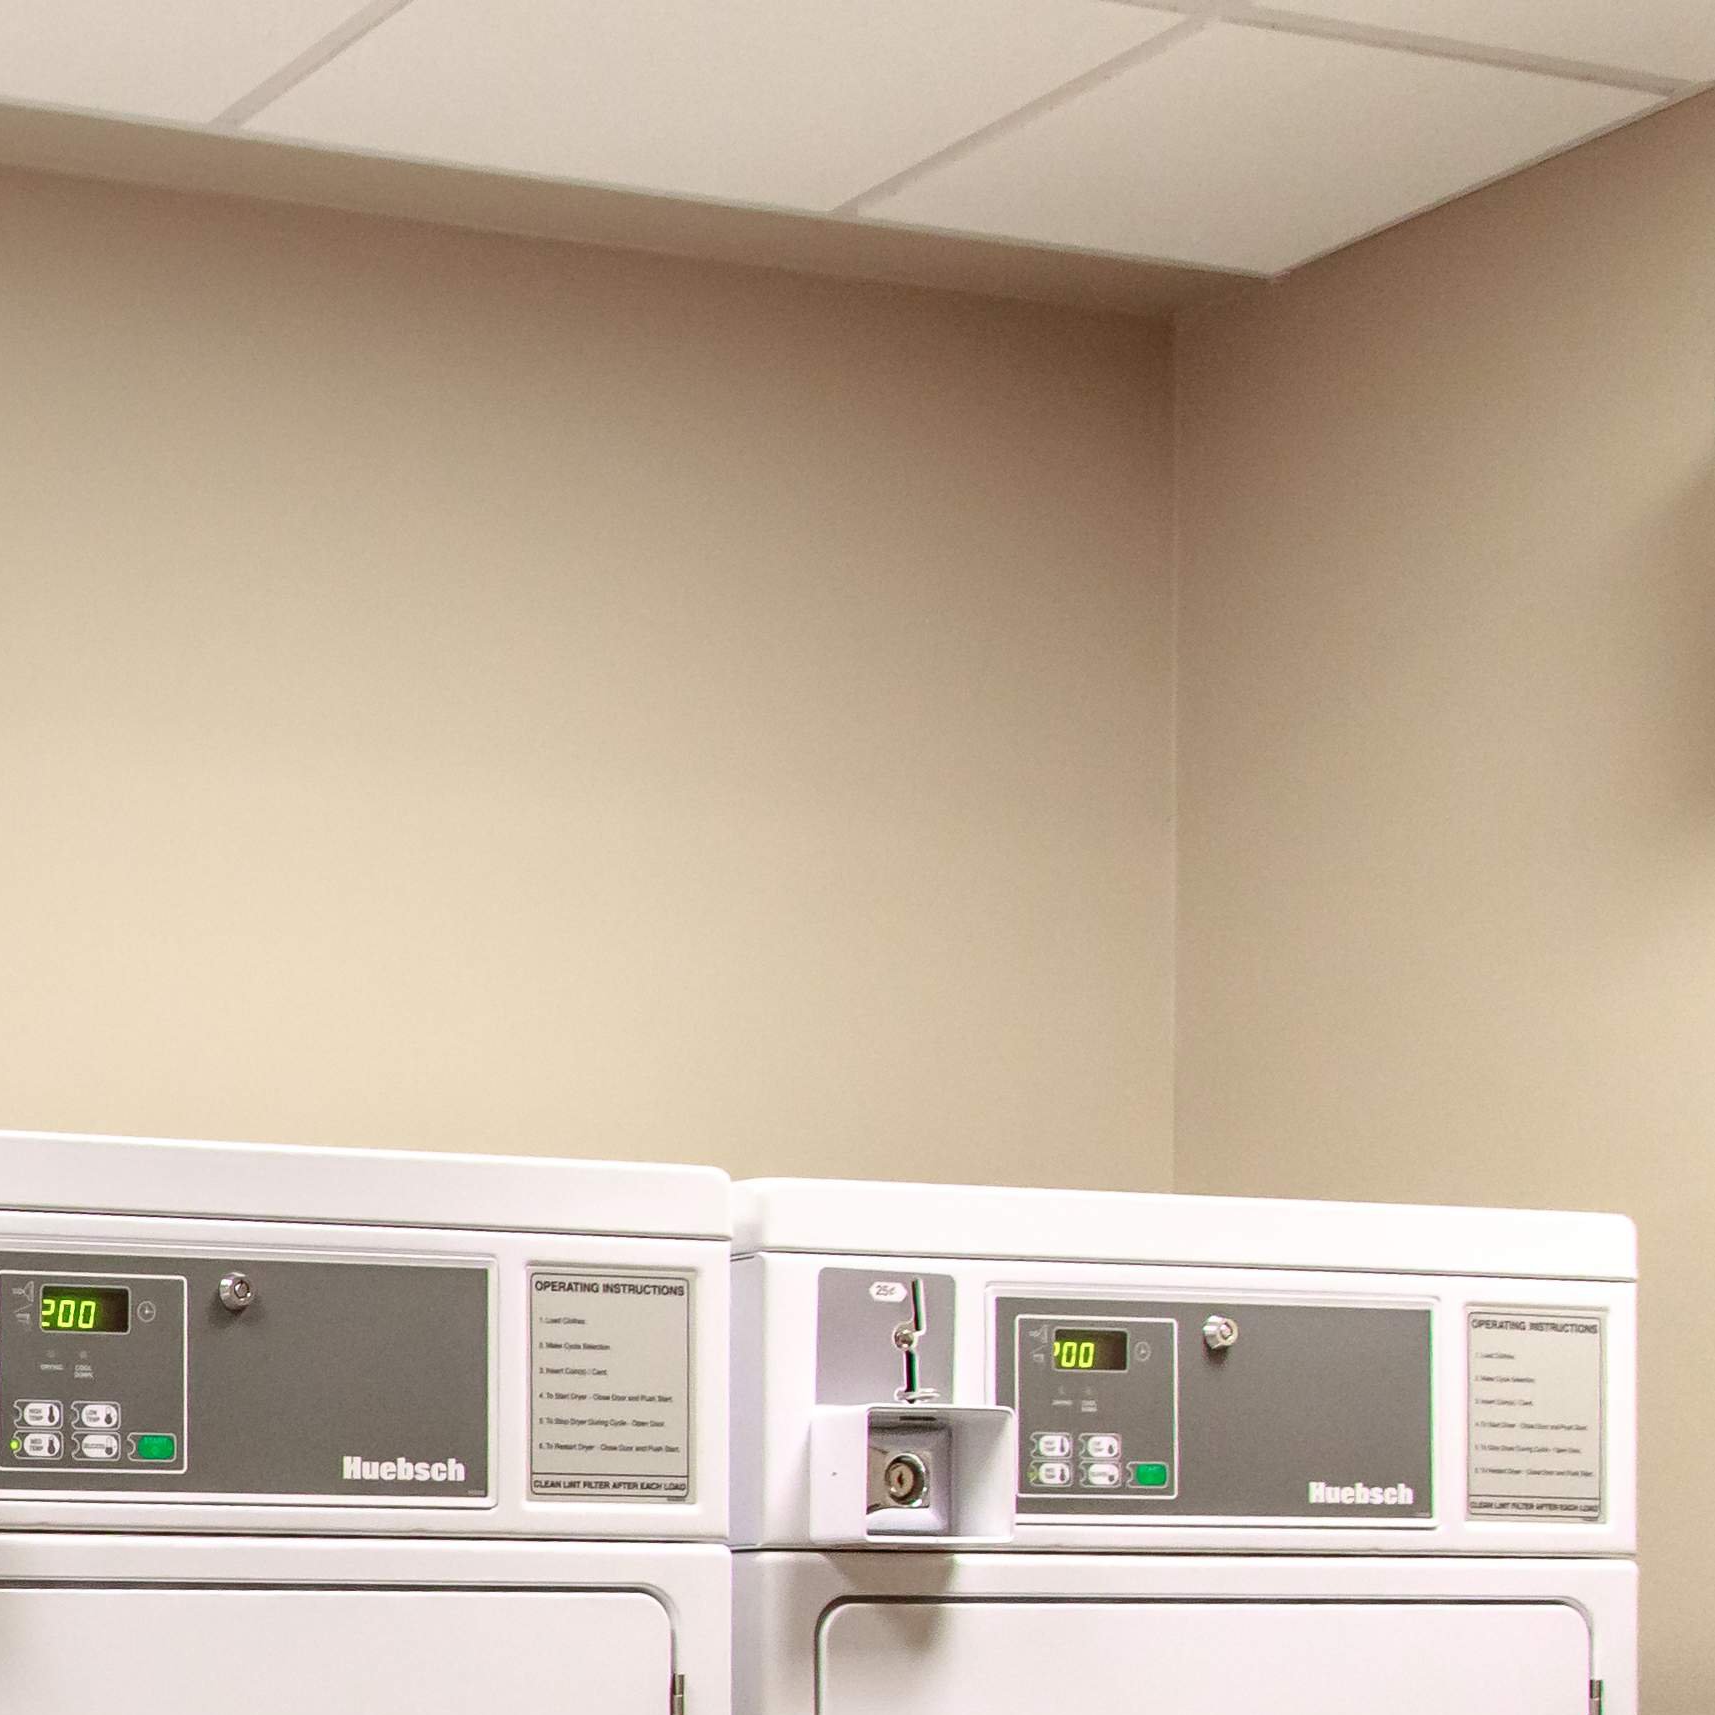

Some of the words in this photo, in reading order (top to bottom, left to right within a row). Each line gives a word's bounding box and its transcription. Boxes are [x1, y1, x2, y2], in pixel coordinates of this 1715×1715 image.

[535, 1280, 599, 1293] OPERATING
[602, 1283, 684, 1296] INSTRUCTIONS
[41, 1299, 95, 1329] 200
[342, 1455, 466, 1482] Huebsch
[1308, 1481, 1414, 1504] Huebsch
